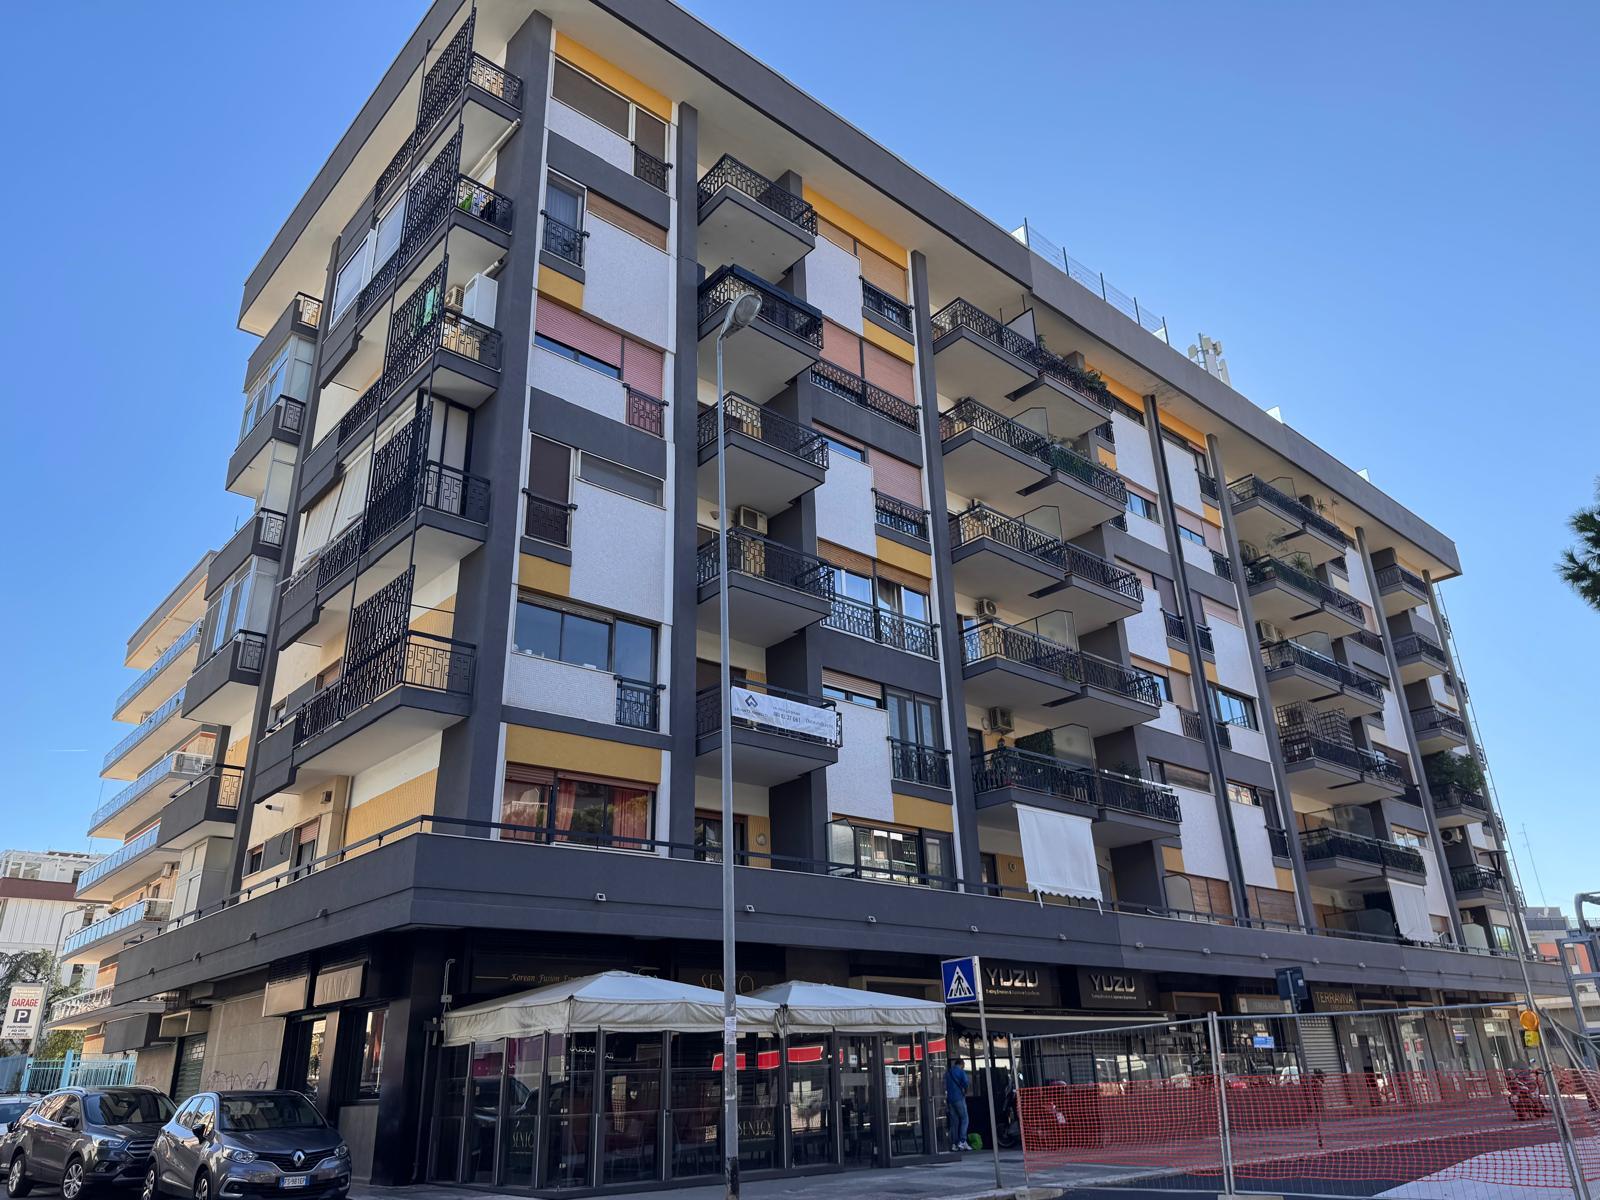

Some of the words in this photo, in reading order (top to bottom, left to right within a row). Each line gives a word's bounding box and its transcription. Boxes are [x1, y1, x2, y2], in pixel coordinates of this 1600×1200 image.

[986, 967, 1039, 987] YUZU
[1090, 974, 1135, 992] YUZU
[11, 998, 39, 1007] GARAGE
[16, 1010, 28, 1022] P
